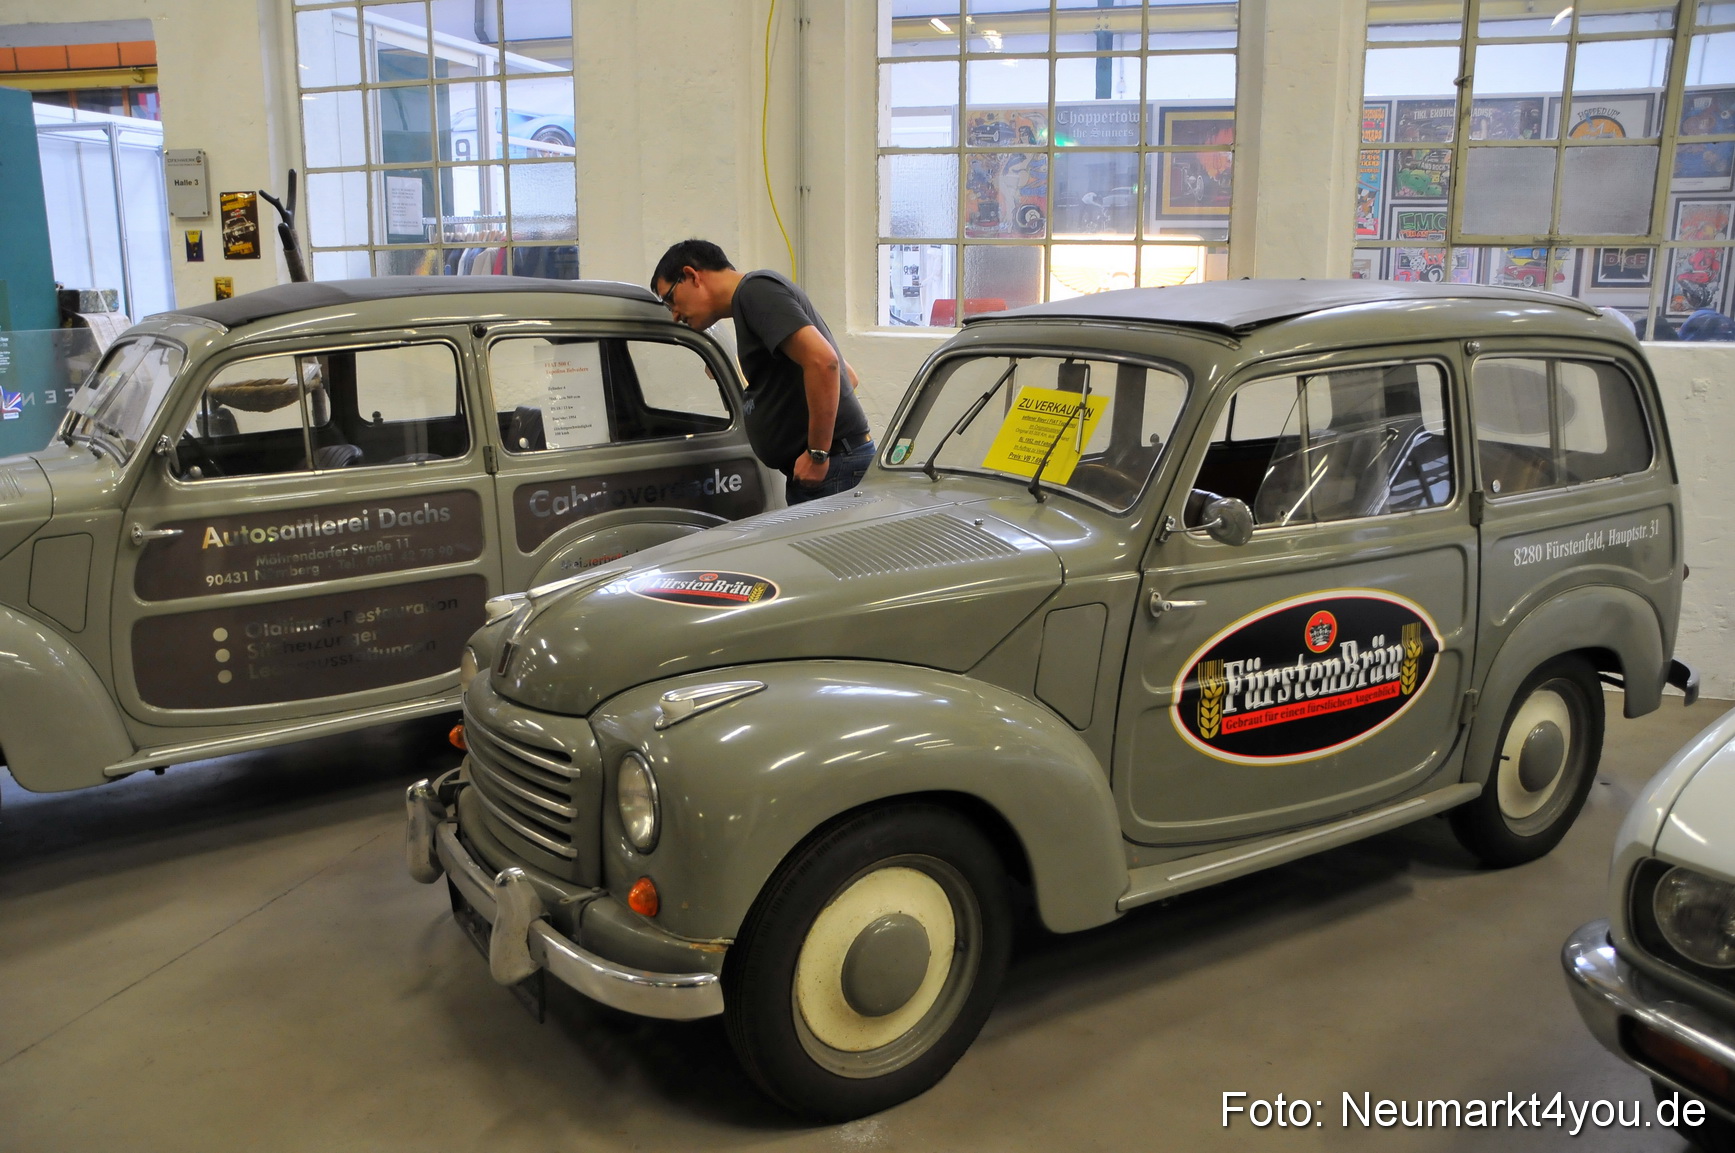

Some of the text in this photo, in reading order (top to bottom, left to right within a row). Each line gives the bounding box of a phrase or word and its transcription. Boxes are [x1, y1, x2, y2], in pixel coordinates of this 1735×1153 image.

[1072, 128, 1088, 138] the
[1090, 127, 1135, 138] Sinners
[174, 179, 193, 187] Halle
[1018, 397, 1034, 409] ZU
[202, 503, 450, 549] Autosattlerei Dachs
[351, 540, 392, 555] Straße
[1513, 519, 1660, 566] 8280 Fürstenfeld, Hauptstr. 31
[205, 570, 249, 587] 90431
[1222, 634, 1403, 714] FürstenBräu
[1225, 685, 1397, 731] Gebraut für einen fürstlichen Augenblick
